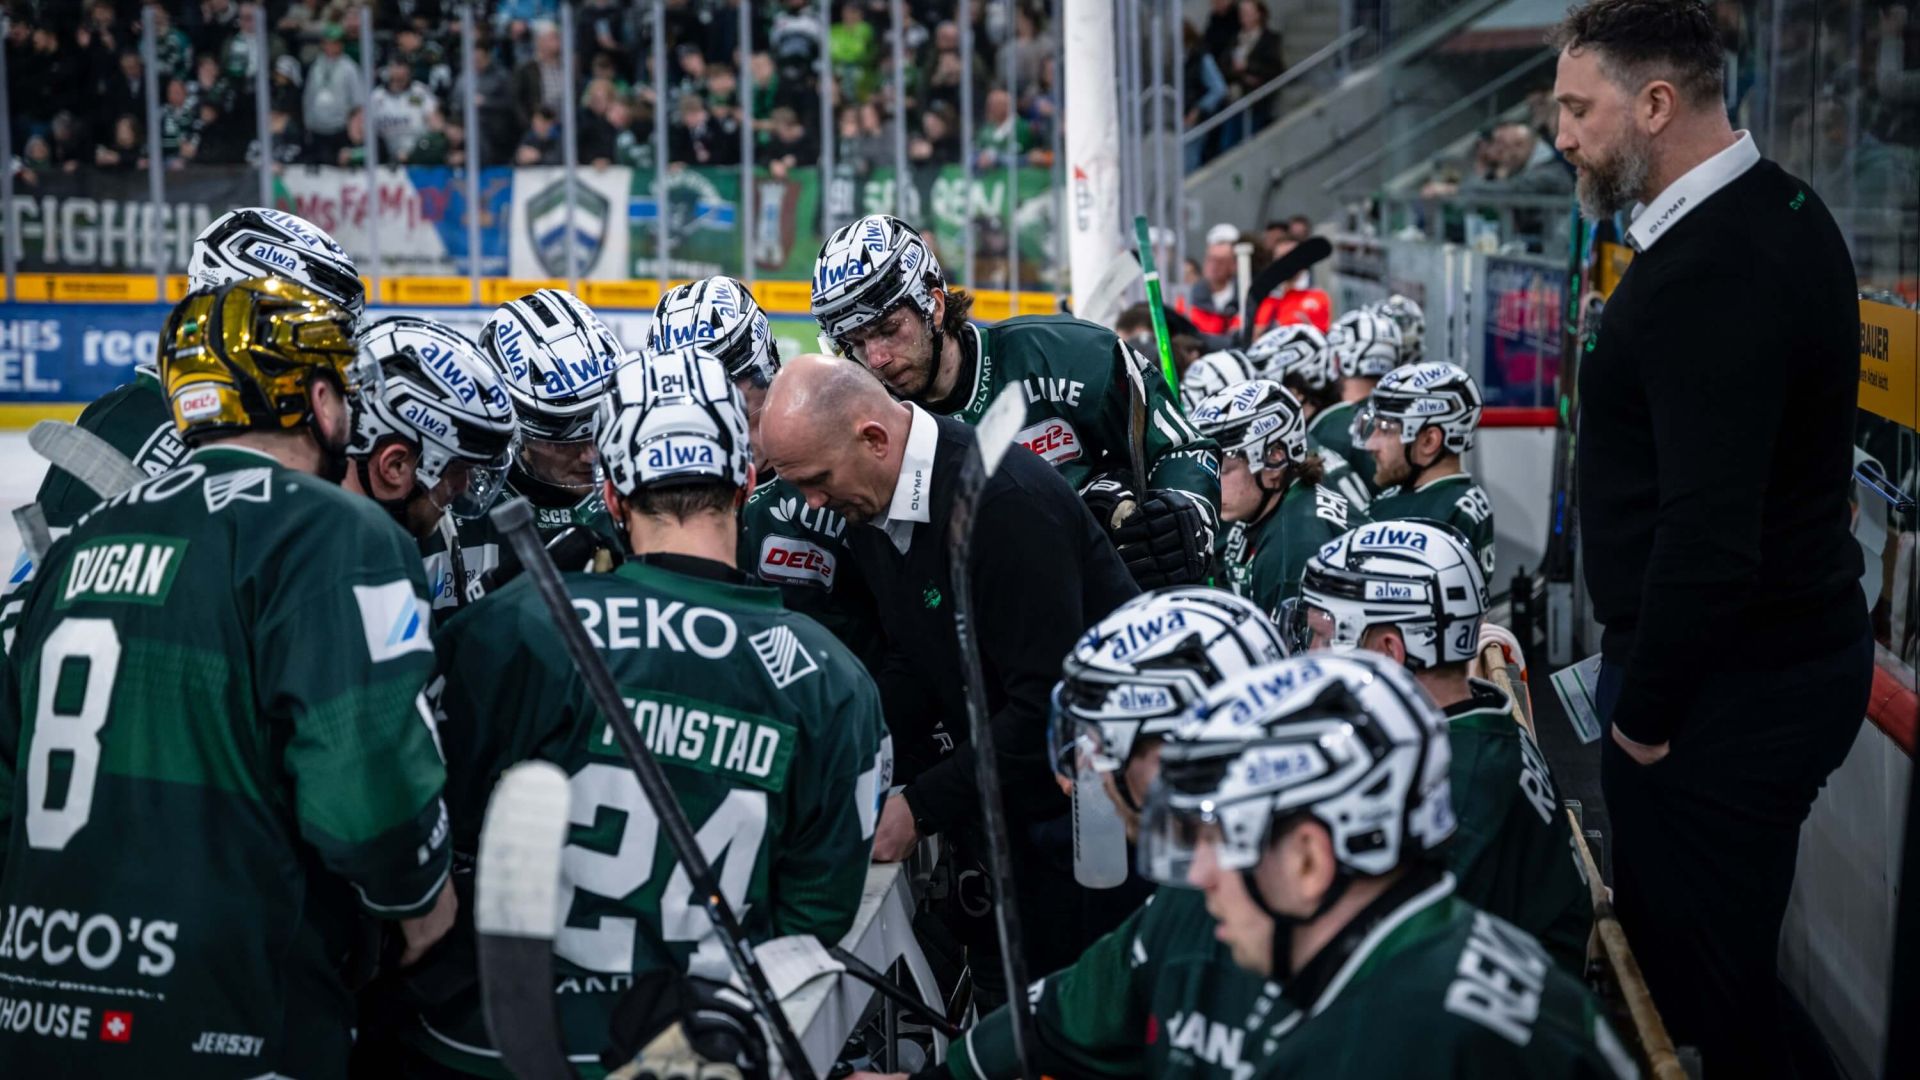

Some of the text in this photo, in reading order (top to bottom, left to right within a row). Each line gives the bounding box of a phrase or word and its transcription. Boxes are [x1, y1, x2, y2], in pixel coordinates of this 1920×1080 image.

[260, 209, 320, 248] alwa
[1649, 196, 1687, 234] OLYMP
[862, 220, 884, 252] alwa
[253, 244, 298, 271] alwa
[904, 244, 920, 269] alwa
[712, 283, 736, 319] alw
[754, 314, 767, 340] alwa
[1861, 321, 1889, 362] BAUER
[498, 320, 528, 381] alwa
[420, 342, 477, 404] alwa
[543, 350, 617, 395] alwa
[661, 374, 684, 394] 24
[973, 356, 992, 415] OLYMP
[1414, 364, 1451, 389] alwa
[405, 404, 449, 437] alwa
[1416, 400, 1446, 413] alwa
[1252, 415, 1279, 435] alwa
[648, 440, 714, 467] alwa
[911, 470, 922, 511] OLYMP
[540, 508, 572, 524] SCB
[1360, 526, 1428, 550] alwa
[64, 543, 175, 601] DUGAN
[765, 547, 832, 578] DEL2
[1375, 581, 1412, 598] alwa
[570, 597, 738, 660] REKO
[1111, 609, 1188, 662] alwa
[1118, 685, 1168, 710] alwa
[1230, 659, 1325, 725] alwa
[27, 618, 122, 850] 8
[1246, 752, 1313, 785] alwa
[554, 762, 768, 977] 24
[1444, 909, 1552, 1047] REK
[0, 997, 92, 1040] HOUSE
